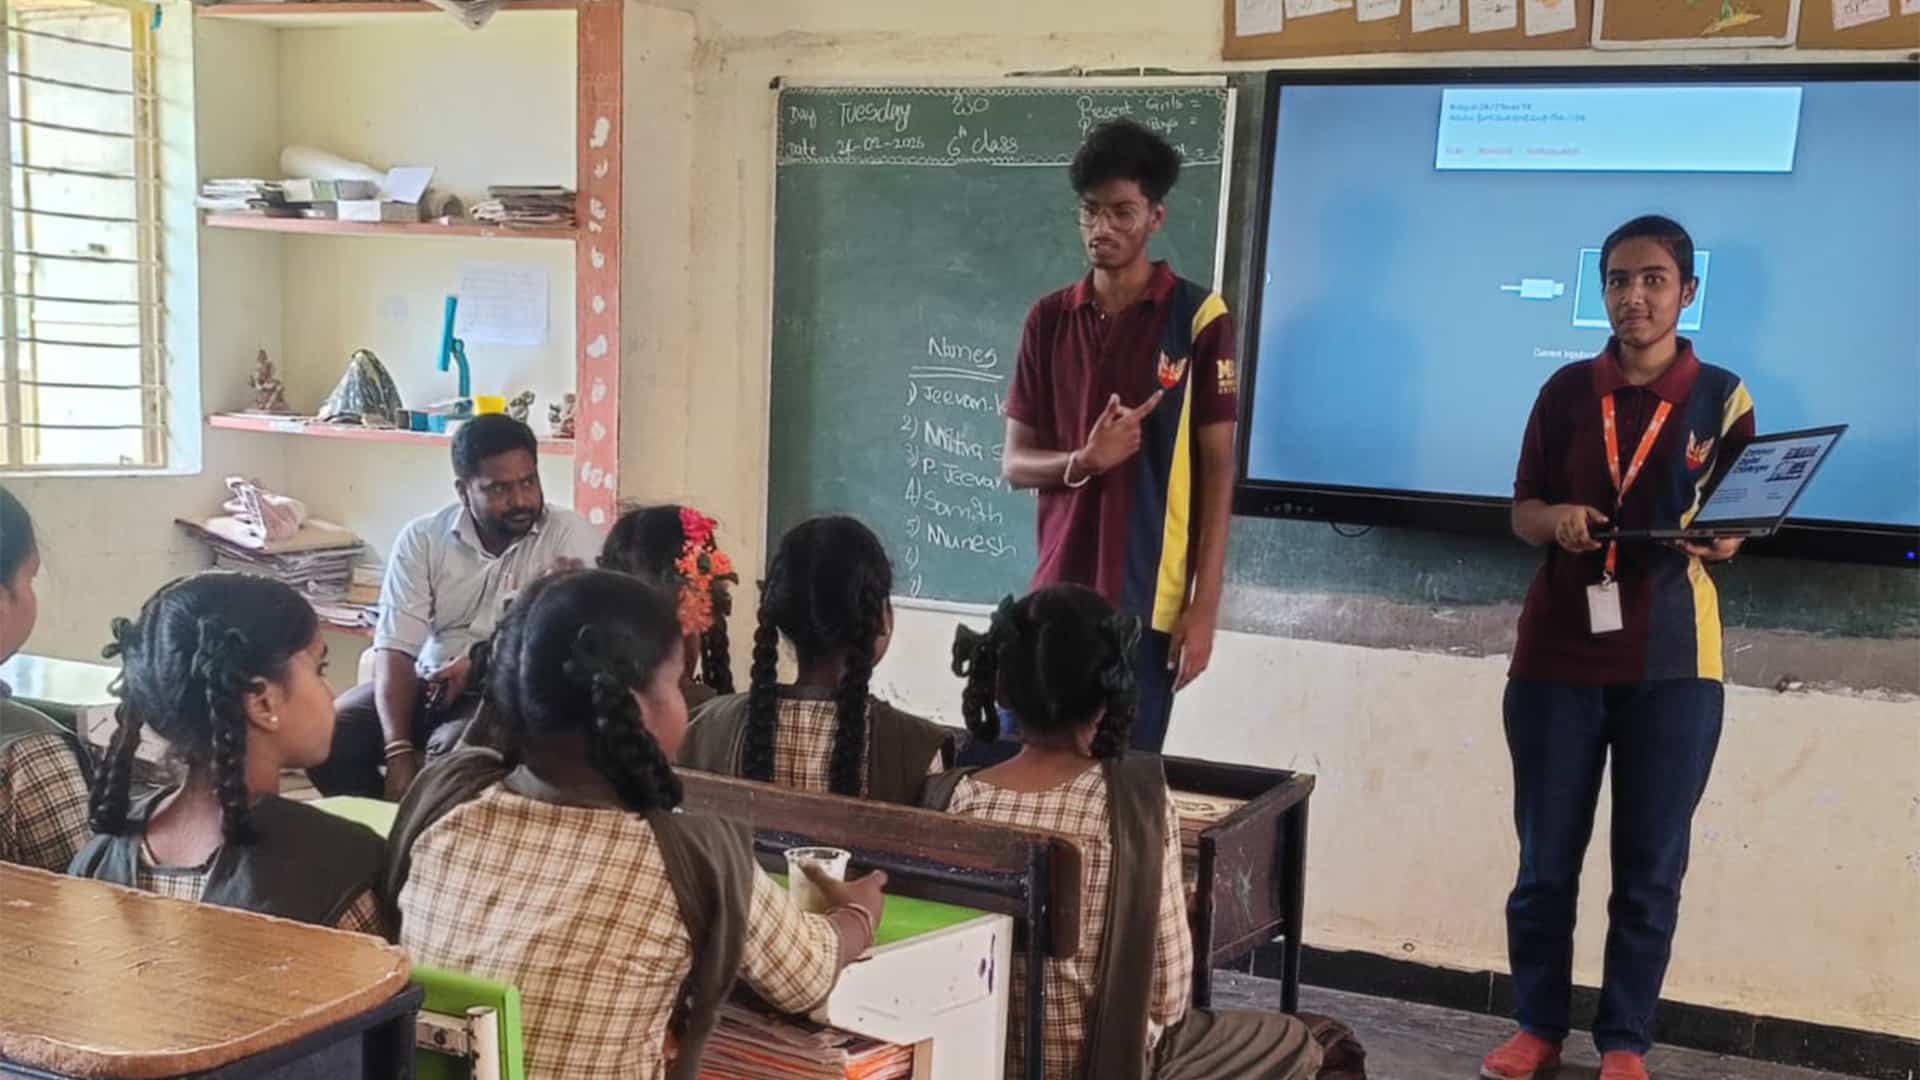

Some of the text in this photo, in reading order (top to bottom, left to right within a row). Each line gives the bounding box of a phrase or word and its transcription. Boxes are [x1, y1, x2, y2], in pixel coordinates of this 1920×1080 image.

[787, 97, 911, 133] Day Tuesday
[785, 137, 817, 159] Date
[971, 127, 1018, 154] class
[927, 335, 998, 369] Names
[899, 413, 919, 440] 2)
